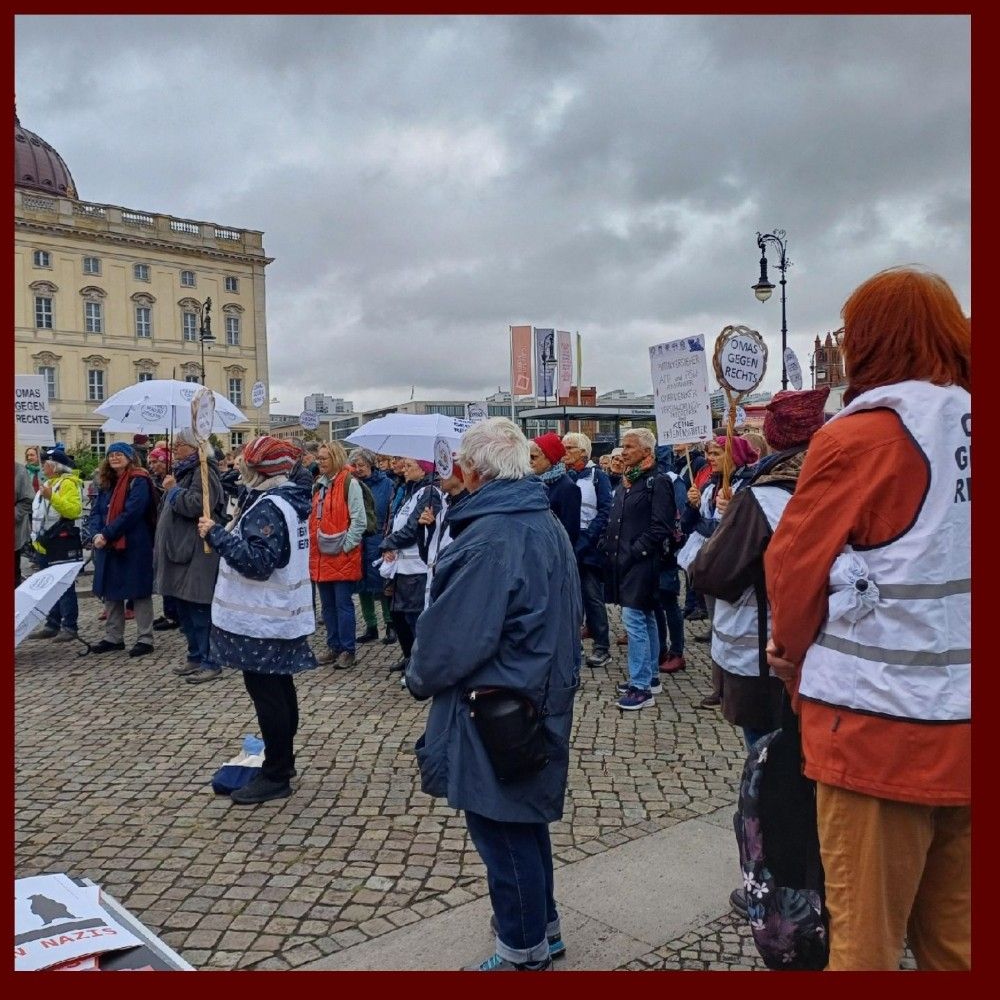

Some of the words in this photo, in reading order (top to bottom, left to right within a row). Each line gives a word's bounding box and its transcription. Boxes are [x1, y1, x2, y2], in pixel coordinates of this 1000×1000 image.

[731, 340, 758, 354] OMAS
[728, 353, 758, 368] GEGEN
[725, 366, 758, 383] RECHTS
[15, 388, 41, 398] OMAS
[15, 401, 46, 411] GEGEN
[15, 414, 49, 424] RECHTS
[954, 445, 972, 471] G
[40, 927, 118, 949] NAZIS
